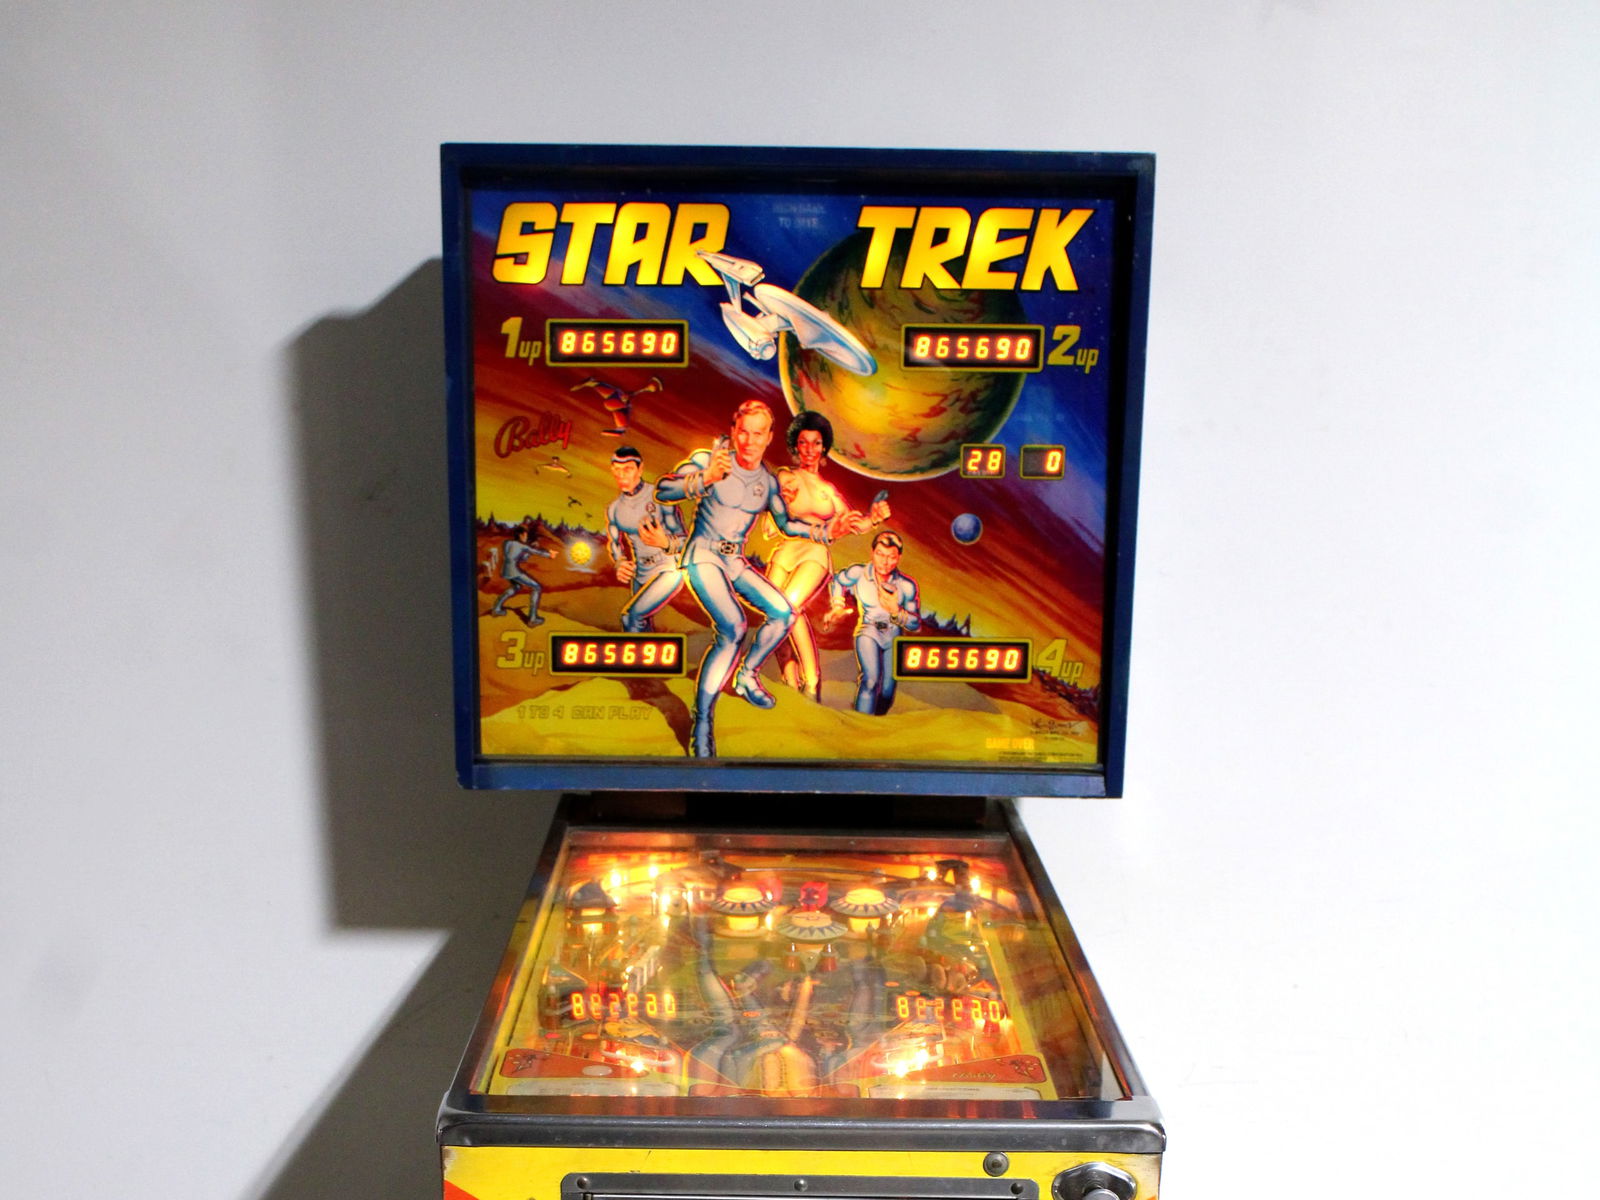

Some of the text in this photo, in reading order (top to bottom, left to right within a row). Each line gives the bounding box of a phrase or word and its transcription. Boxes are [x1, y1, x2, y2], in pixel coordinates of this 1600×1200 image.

[492, 202, 731, 286] STAR
[856, 205, 1095, 291] TREK
[559, 330, 679, 355] 865690
[914, 334, 1031, 360] 865690
[494, 411, 573, 459] Bally
[966, 449, 1002, 471] 28
[1045, 450, 1062, 472] 0
[563, 642, 677, 665] 865690
[906, 647, 1021, 670] 865690
[571, 705, 606, 719] CAN
[608, 705, 653, 719] PLAY
[1011, 737, 1035, 750] OVER
